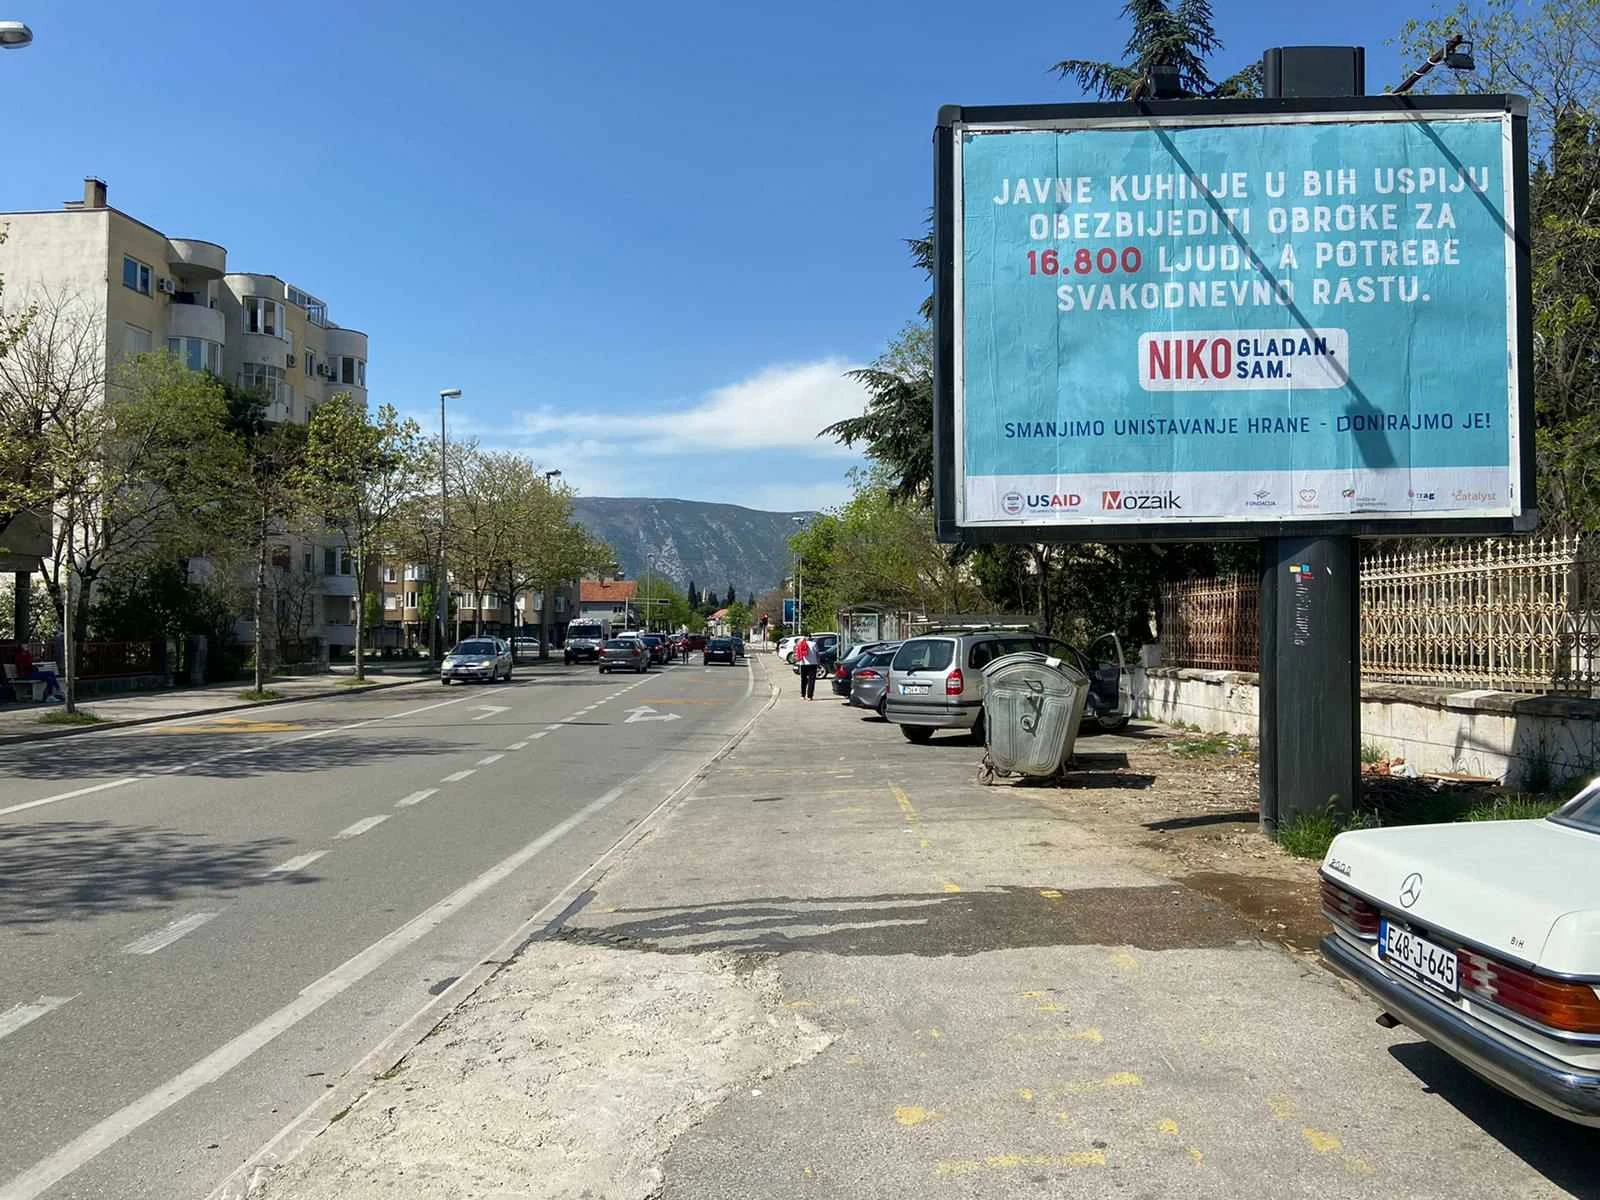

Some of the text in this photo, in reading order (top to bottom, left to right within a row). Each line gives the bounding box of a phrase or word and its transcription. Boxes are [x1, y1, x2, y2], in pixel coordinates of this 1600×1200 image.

[993, 167, 1489, 204] JAVNE KUHINJE U BIH USPIJU
[1029, 202, 1457, 241] OBEZBIJEDITI OBROKE ZA
[1027, 246, 1142, 276] 16.800
[1279, 243, 1299, 269] A
[1316, 238, 1460, 270] POTREBE
[1057, 275, 1431, 312] SVAKODNEVNO RASTU.
[1149, 337, 1335, 380] NIKO GLADAN.
[1236, 360, 1292, 379] SAM.
[1005, 420, 1105, 438] SMANJIMO
[1248, 416, 1310, 434] HRANE
[1336, 413, 1453, 433] DONIRAJMO
[1462, 413, 1491, 430] JE!
[1027, 494, 1081, 507] USAID
[1103, 490, 1181, 509] Mozaik
[1387, 927, 1454, 985] E48-J-645
